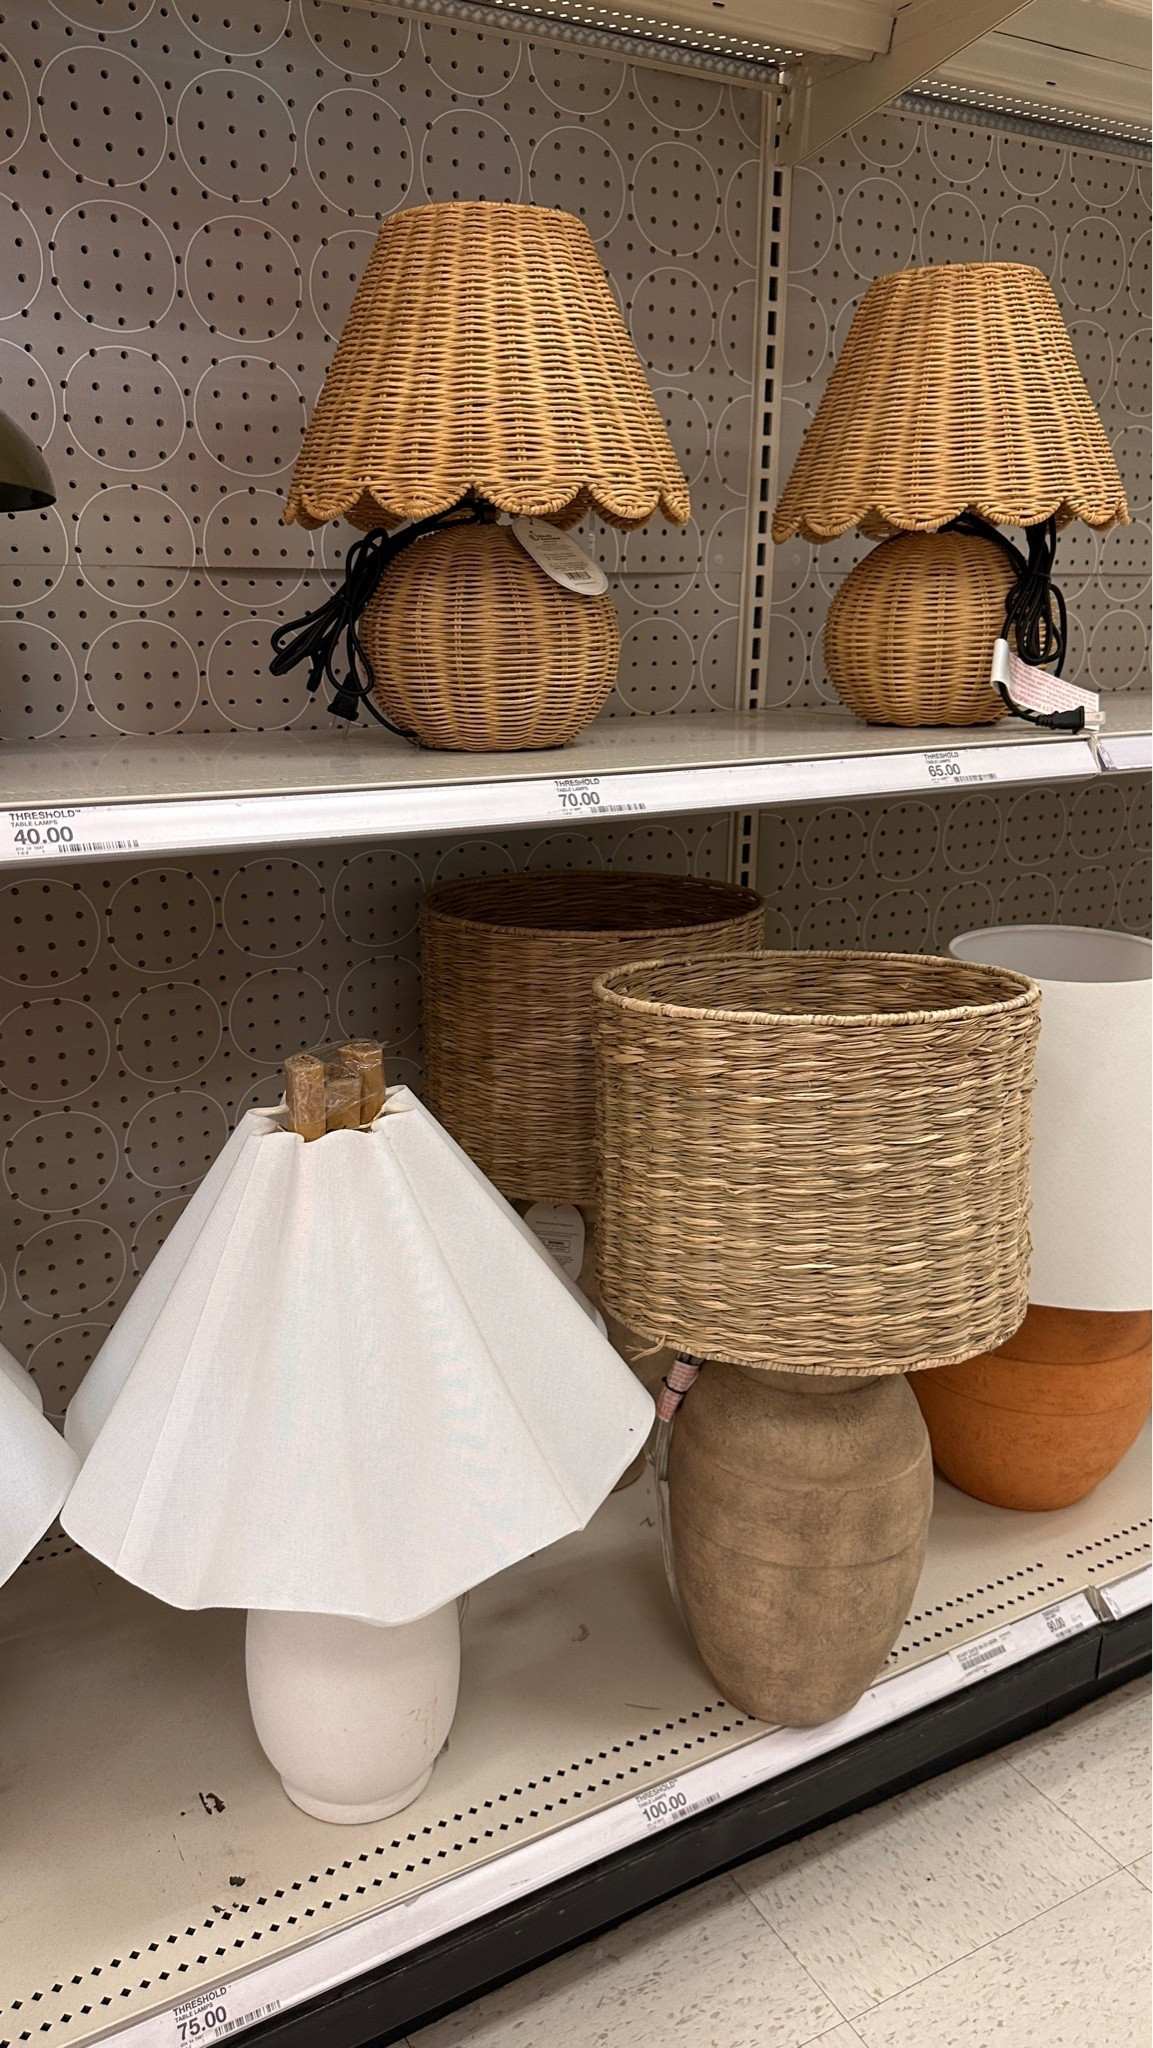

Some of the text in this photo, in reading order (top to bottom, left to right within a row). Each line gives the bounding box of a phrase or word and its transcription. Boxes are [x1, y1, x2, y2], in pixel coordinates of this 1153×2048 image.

[928, 763, 961, 777] 65.00
[554, 778, 600, 787] THRESHOLD
[558, 791, 600, 807] 70.00
[14, 826, 74, 845] 40.00
[643, 1792, 687, 1821] 100.00
[175, 2002, 214, 2023] TABLE LAMPS
[177, 2006, 227, 2041] 75.00
